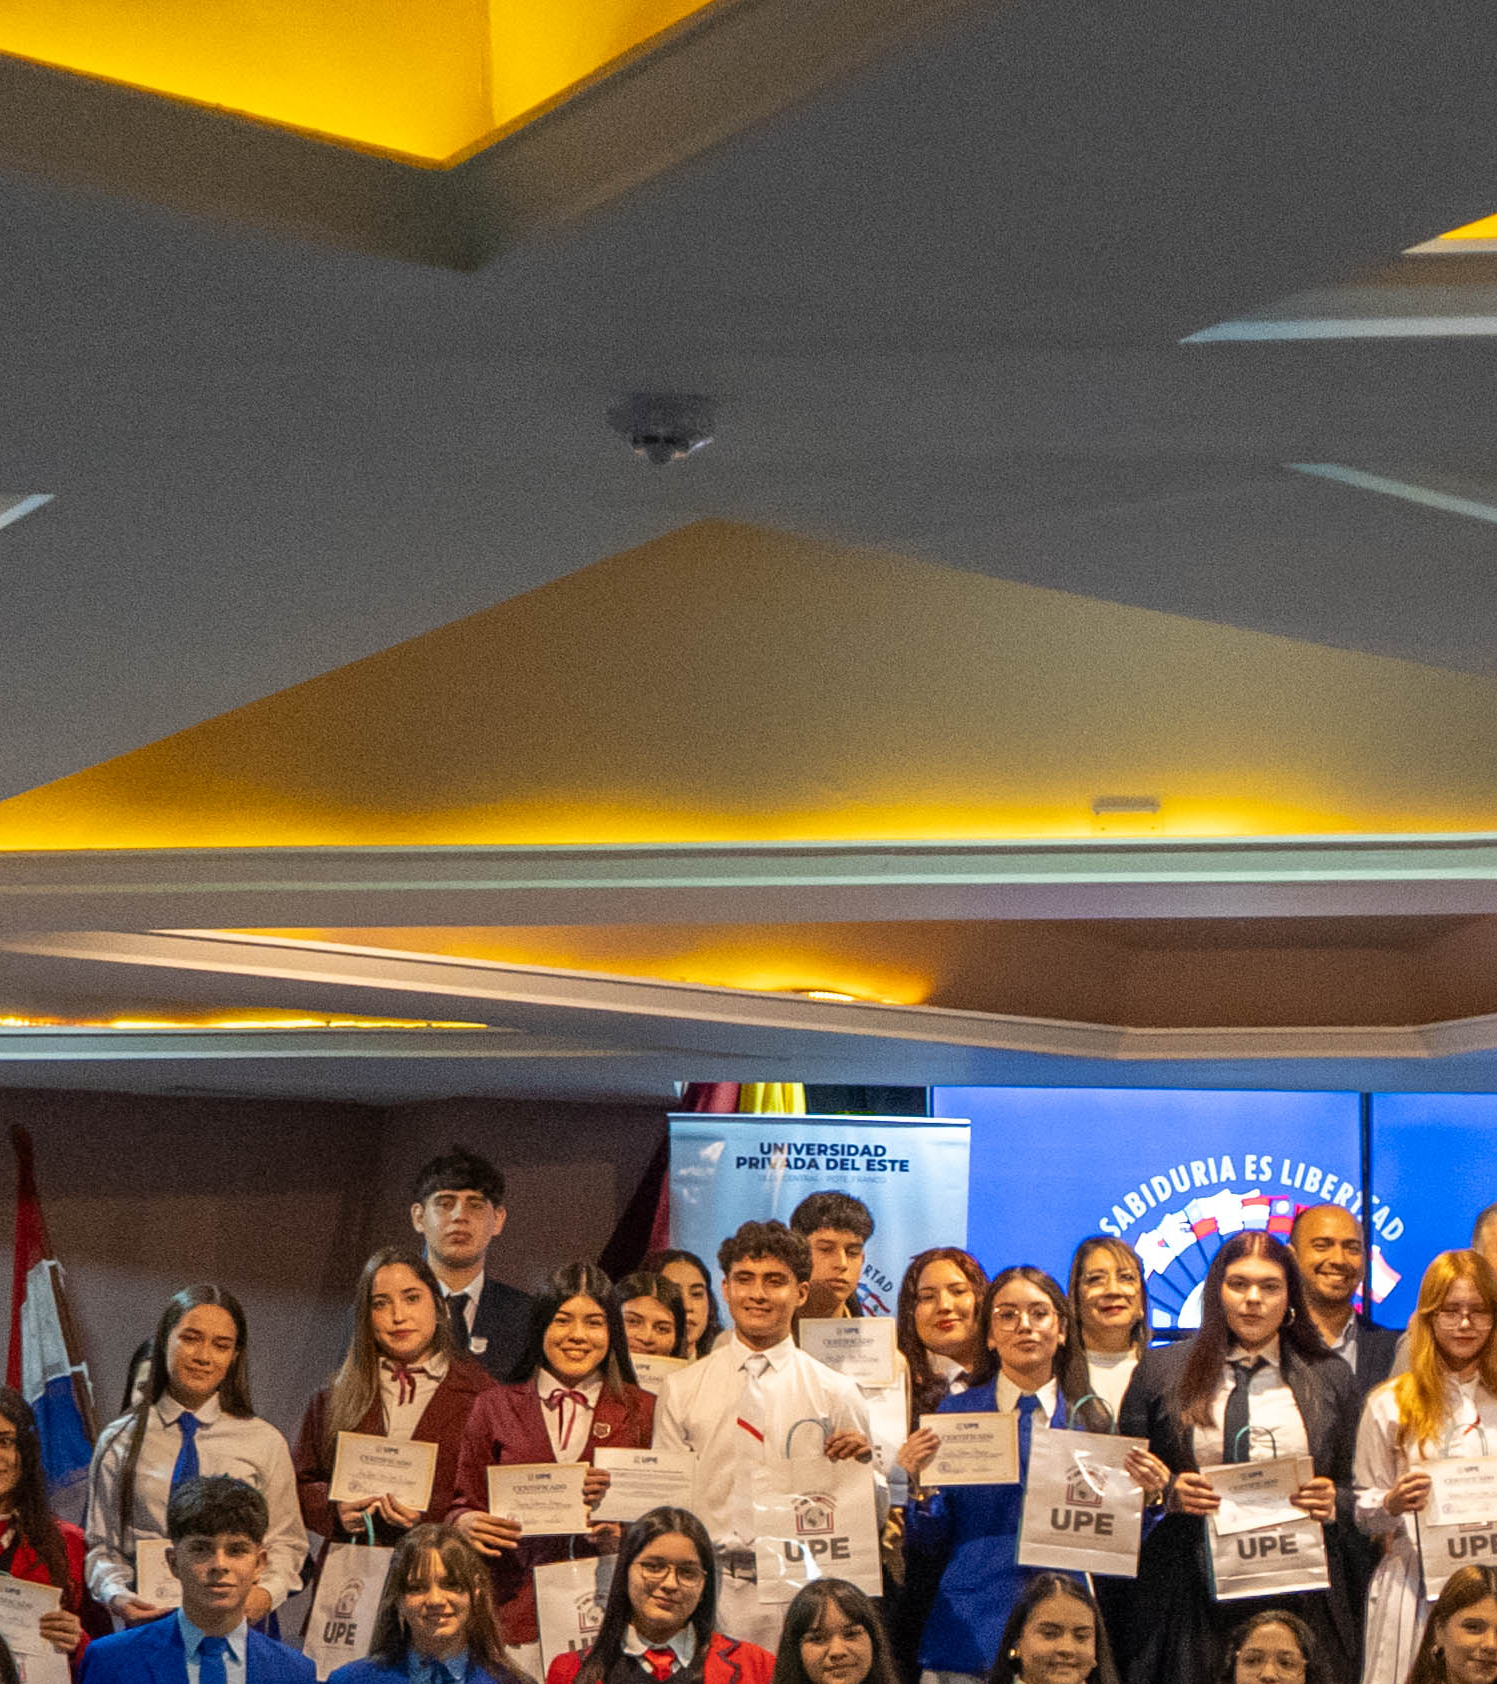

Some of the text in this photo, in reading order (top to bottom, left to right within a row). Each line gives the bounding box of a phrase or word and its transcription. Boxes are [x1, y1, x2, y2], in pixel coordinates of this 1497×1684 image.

[760, 1142, 887, 1157] UNIVERSIDAD
[736, 1156, 909, 1172] PRIVADA DEL ESTE
[1098, 1155, 1236, 1238] SABIDURIA
[1245, 1154, 1273, 1182] ES
[863, 1264, 894, 1293] RTAD
[1051, 1508, 1114, 1535] UPE
[784, 1537, 850, 1562] UPE
[1237, 1533, 1299, 1560] UPE
[5, 1587, 21, 1595] UPE
[323, 1622, 358, 1646] UPE
